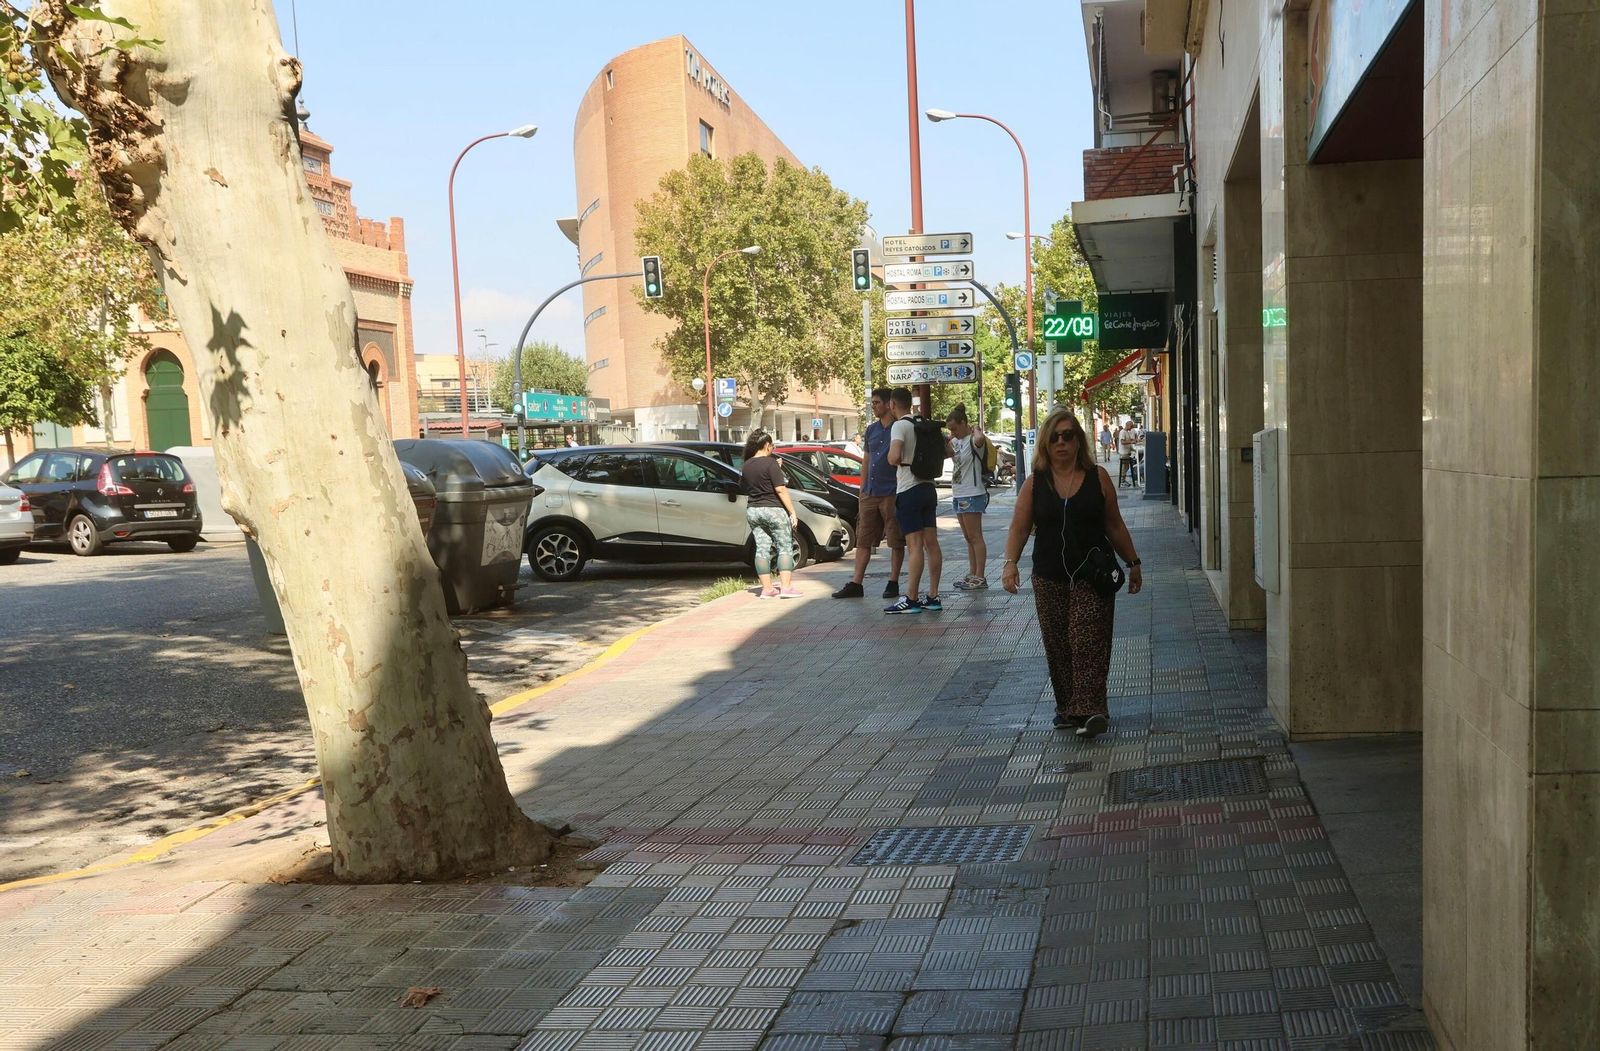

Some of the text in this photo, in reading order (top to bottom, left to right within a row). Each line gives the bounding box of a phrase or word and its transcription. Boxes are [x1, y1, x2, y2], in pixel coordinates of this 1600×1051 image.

[886, 268, 922, 277] HOSTAL ROMA
[887, 295, 925, 305] HOSTAL PACOS
[1045, 317, 1093, 336] 22/09
[1113, 319, 1132, 330] Corte
